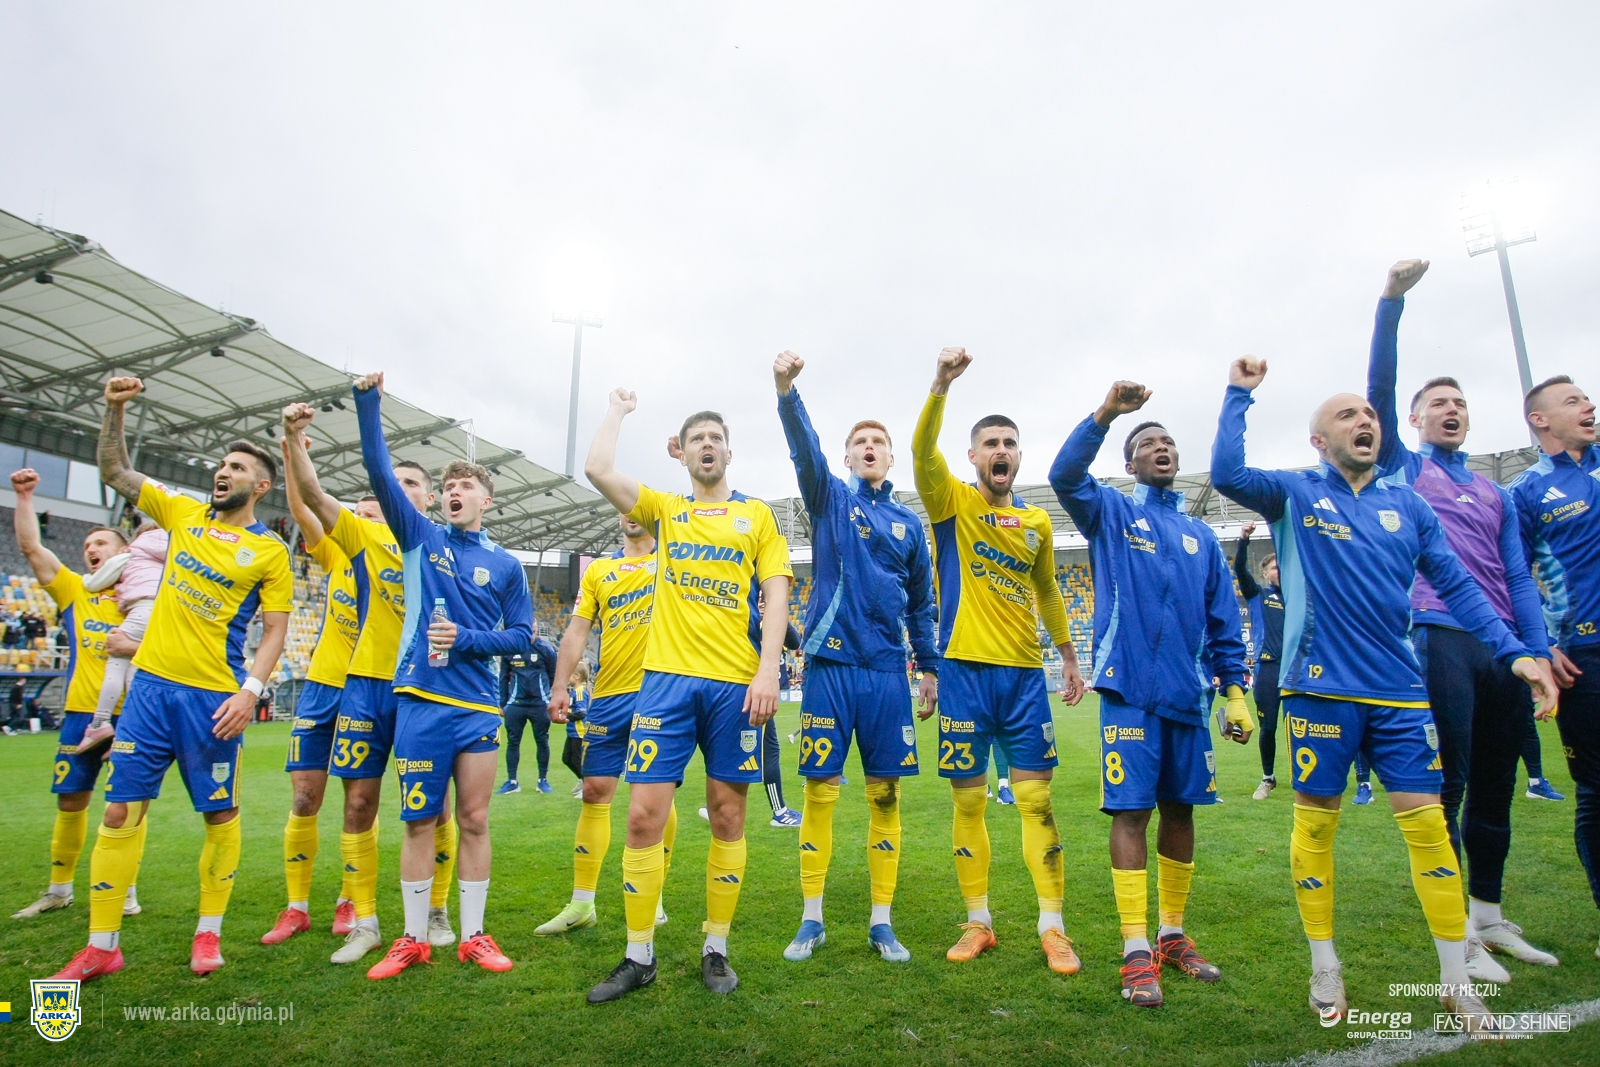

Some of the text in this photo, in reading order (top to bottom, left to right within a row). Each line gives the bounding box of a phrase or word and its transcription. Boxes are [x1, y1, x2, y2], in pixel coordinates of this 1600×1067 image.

[1552, 500, 1585, 516] Energa
[1000, 517, 1018, 526] tclic
[1129, 535, 1156, 549] Energa
[667, 541, 744, 566] GDYNIA
[174, 551, 235, 590] GDYNIA
[680, 571, 740, 596] Energa
[176, 580, 223, 610] Energa
[332, 589, 357, 608] GDY
[607, 584, 653, 609] GDYNI
[706, 596, 738, 609] ORLEN
[83, 619, 119, 634] GDY
[335, 614, 358, 629] Ene
[1576, 622, 1597, 636] 32
[826, 636, 842, 650] 32
[1105, 667, 1114, 678] 6
[1309, 664, 1323, 679] 19
[350, 719, 373, 728] SOCIOS
[638, 716, 662, 726] SOCIOS
[812, 716, 835, 725] SOCIOS
[951, 721, 974, 729] SOCIOS
[1308, 723, 1341, 733] SOCIOS
[589, 724, 608, 733] SOCIOS
[1118, 727, 1145, 736] SOCIOS
[334, 738, 370, 769] 39
[627, 739, 658, 772] 29
[800, 736, 832, 766] 99
[939, 740, 975, 770] 23
[408, 760, 433, 768] SOCIOS
[1105, 751, 1125, 785] 8
[1296, 747, 1317, 782] 9
[402, 782, 426, 810] 16
